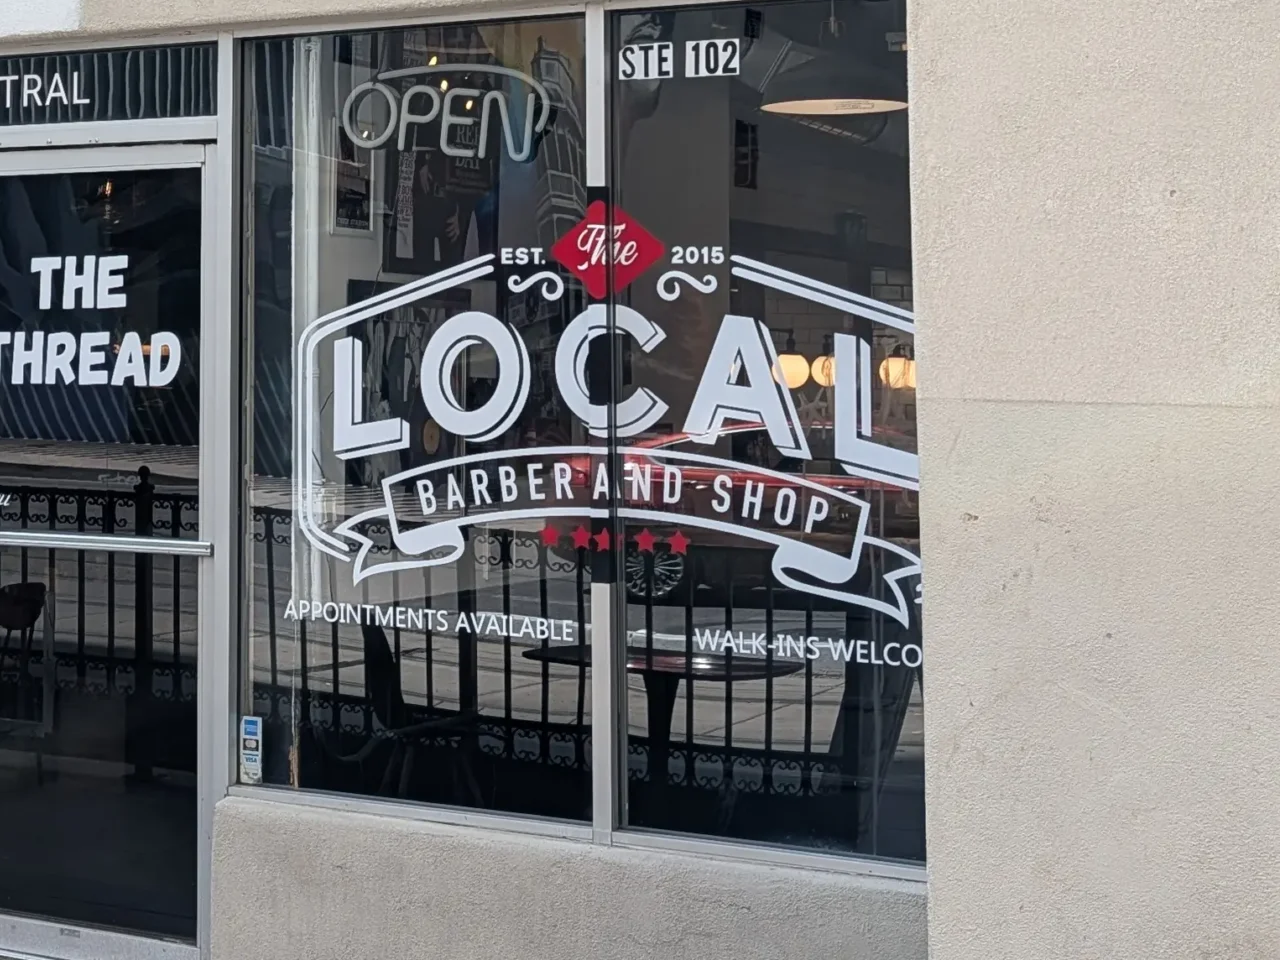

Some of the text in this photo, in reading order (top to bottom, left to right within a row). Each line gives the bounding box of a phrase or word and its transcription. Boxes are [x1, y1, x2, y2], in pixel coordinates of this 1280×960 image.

[621, 39, 738, 79] STE 102
[342, 81, 536, 162] OPEN
[500, 223, 725, 271] EST. The 2015
[30, 255, 129, 310] THE
[333, 304, 919, 490] LOCAL
[417, 460, 830, 534] BARBER AND SHOP
[283, 599, 574, 642] APPOINTMENTS AVAILABLE
[694, 628, 820, 660] WALK-INS
